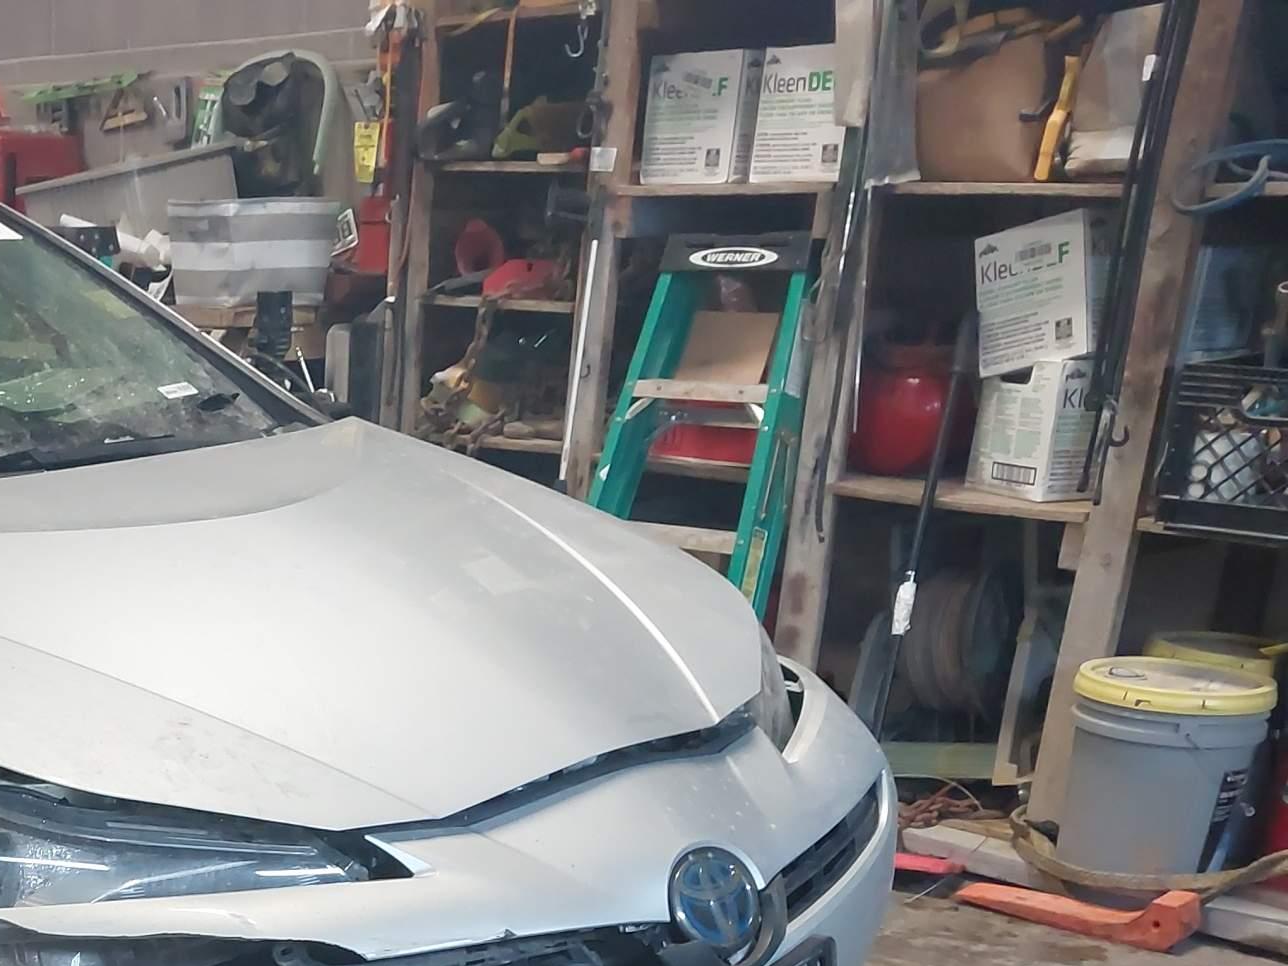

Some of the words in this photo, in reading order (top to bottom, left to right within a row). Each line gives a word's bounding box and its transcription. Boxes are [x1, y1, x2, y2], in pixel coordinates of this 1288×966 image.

[652, 77, 728, 101] KleeF
[762, 70, 836, 94] KleenDE
[706, 252, 761, 263] WERNER
